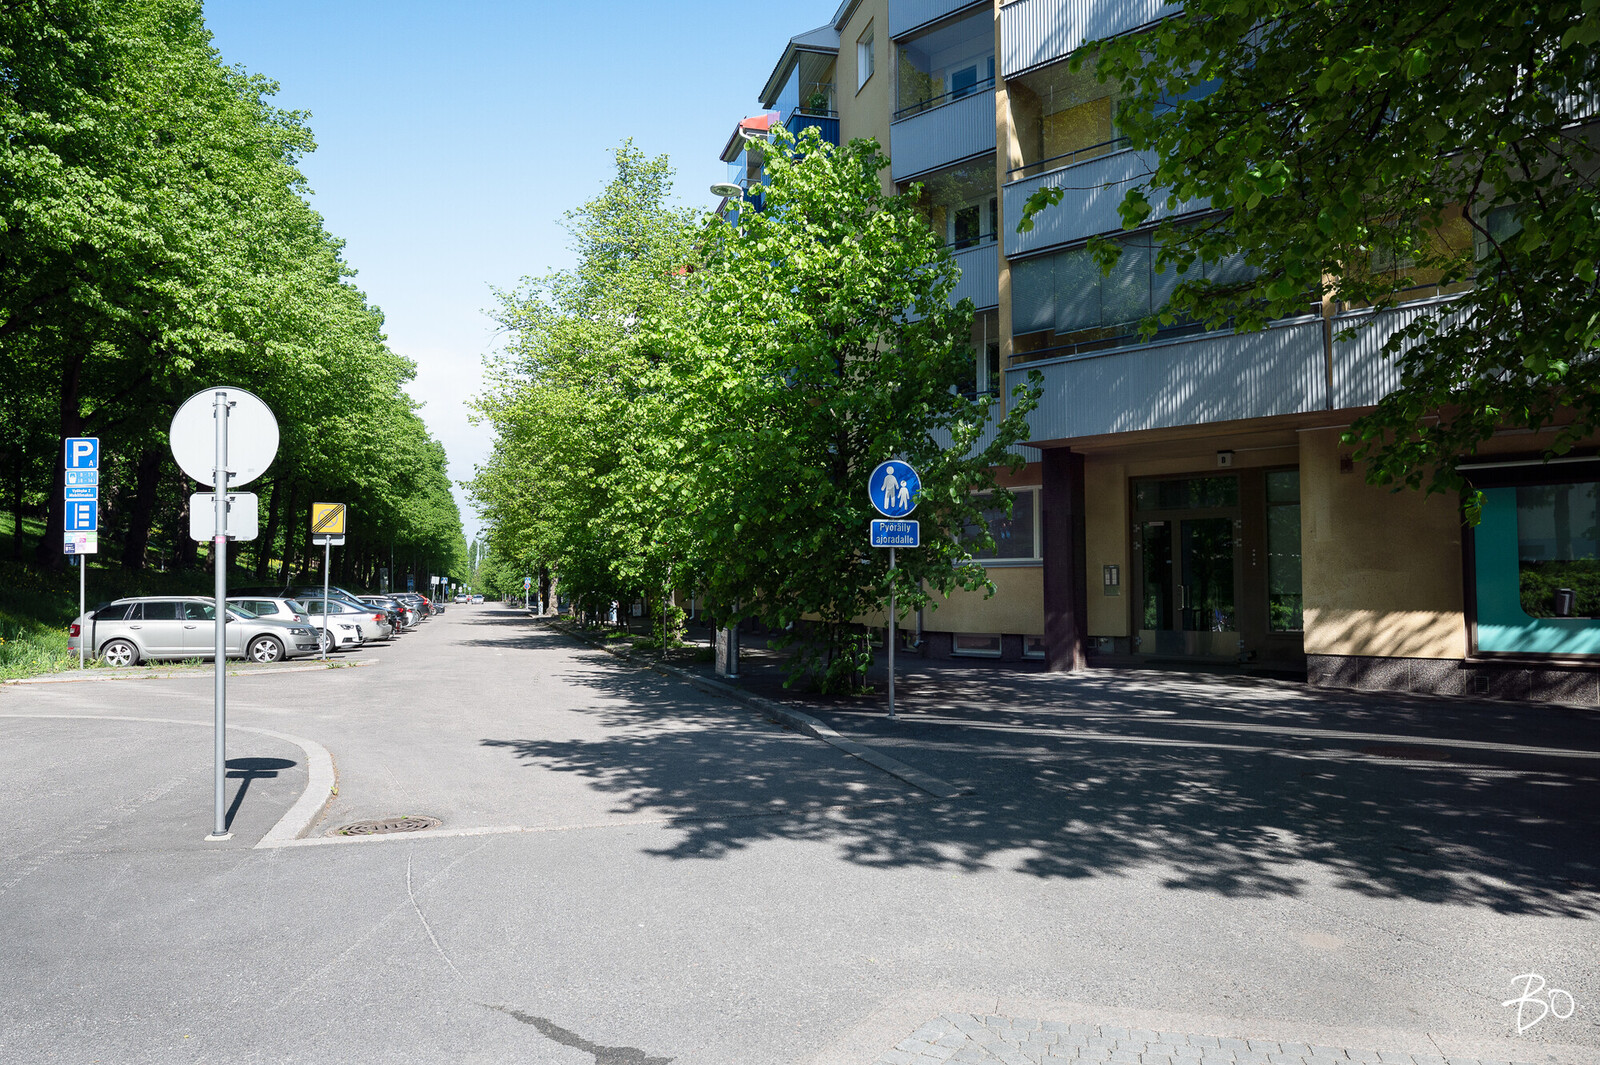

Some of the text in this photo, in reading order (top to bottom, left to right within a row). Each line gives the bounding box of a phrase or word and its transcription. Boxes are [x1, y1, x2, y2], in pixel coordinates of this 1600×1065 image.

[72, 441, 94, 467] P
[880, 523, 911, 533] Pyöräily
[876, 535, 914, 544] ajoradalle
